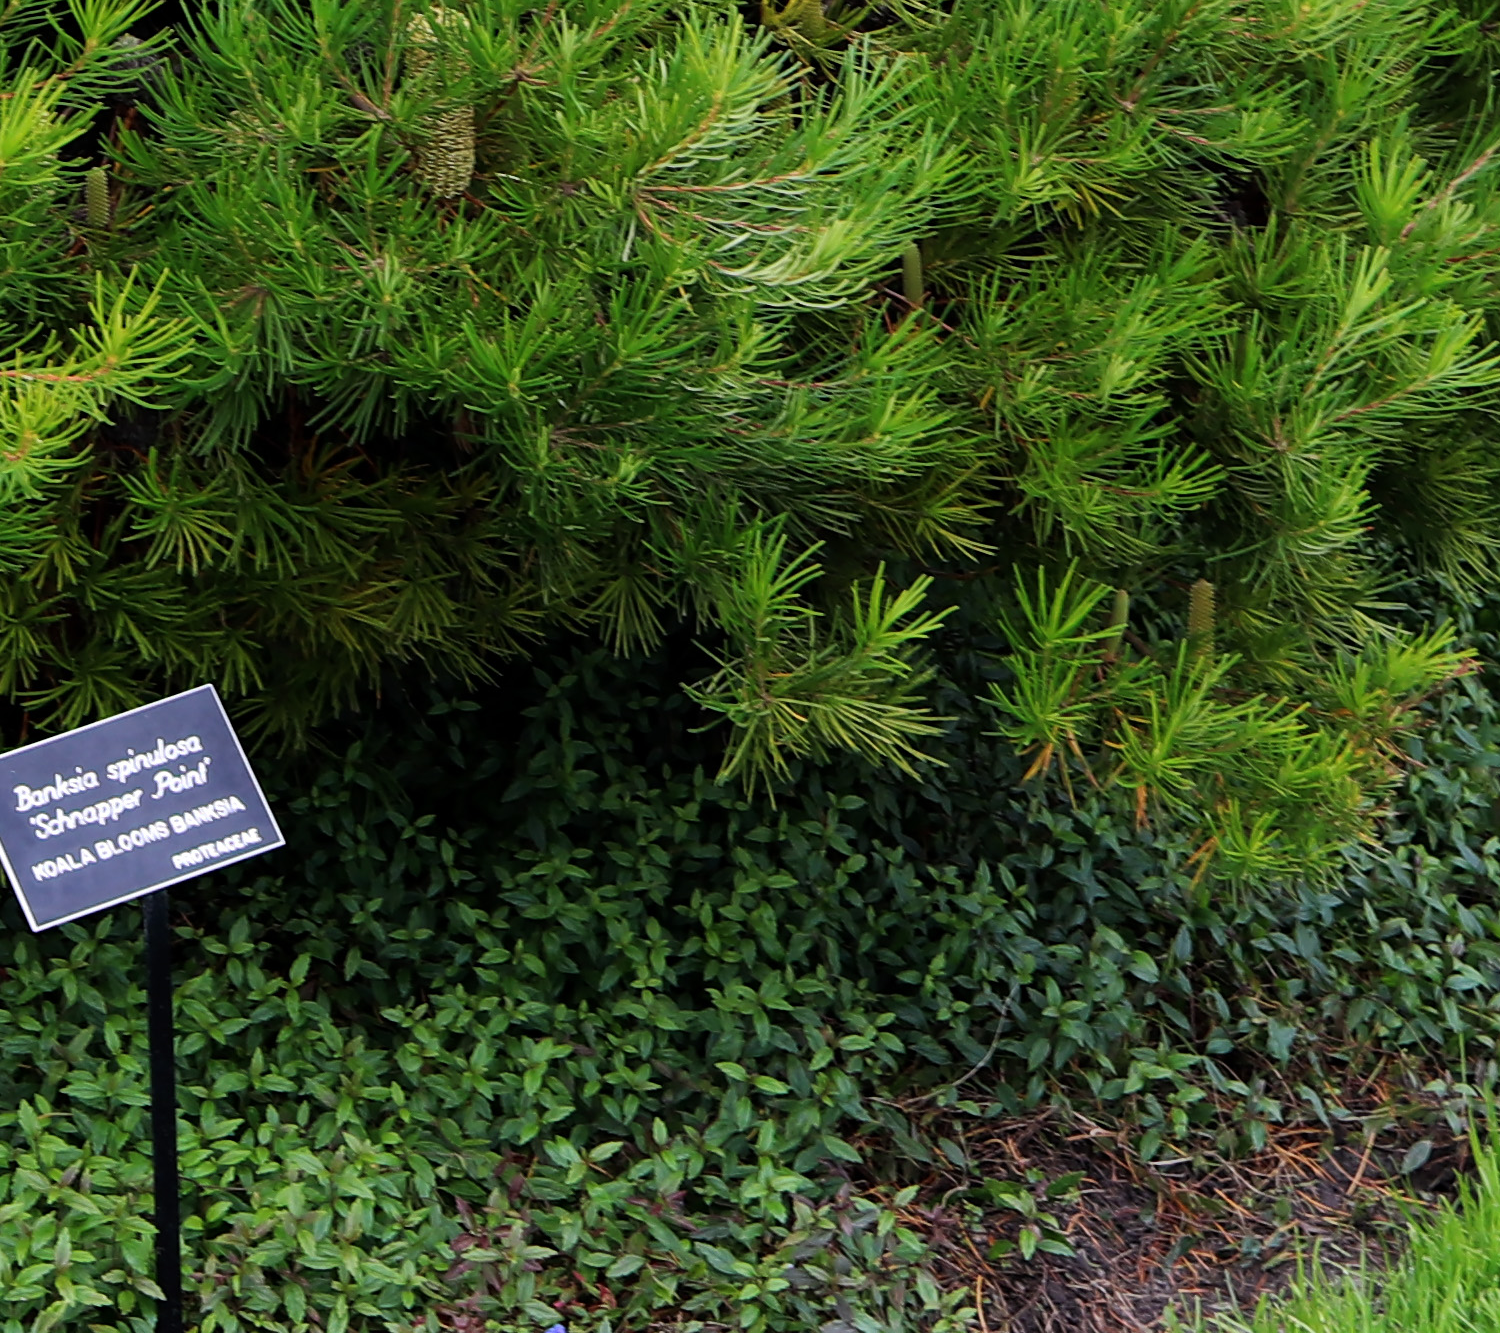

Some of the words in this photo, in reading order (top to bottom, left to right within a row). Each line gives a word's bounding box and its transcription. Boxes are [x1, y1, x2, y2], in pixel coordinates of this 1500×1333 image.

[13, 767, 100, 811] Banksia
[106, 736, 203, 783] spinulosa
[31, 848, 96, 882] KOALA
[94, 821, 170, 860] BLOOMS
[169, 795, 246, 834] BANKSIA
[171, 828, 262, 870] PROTEACEAE
